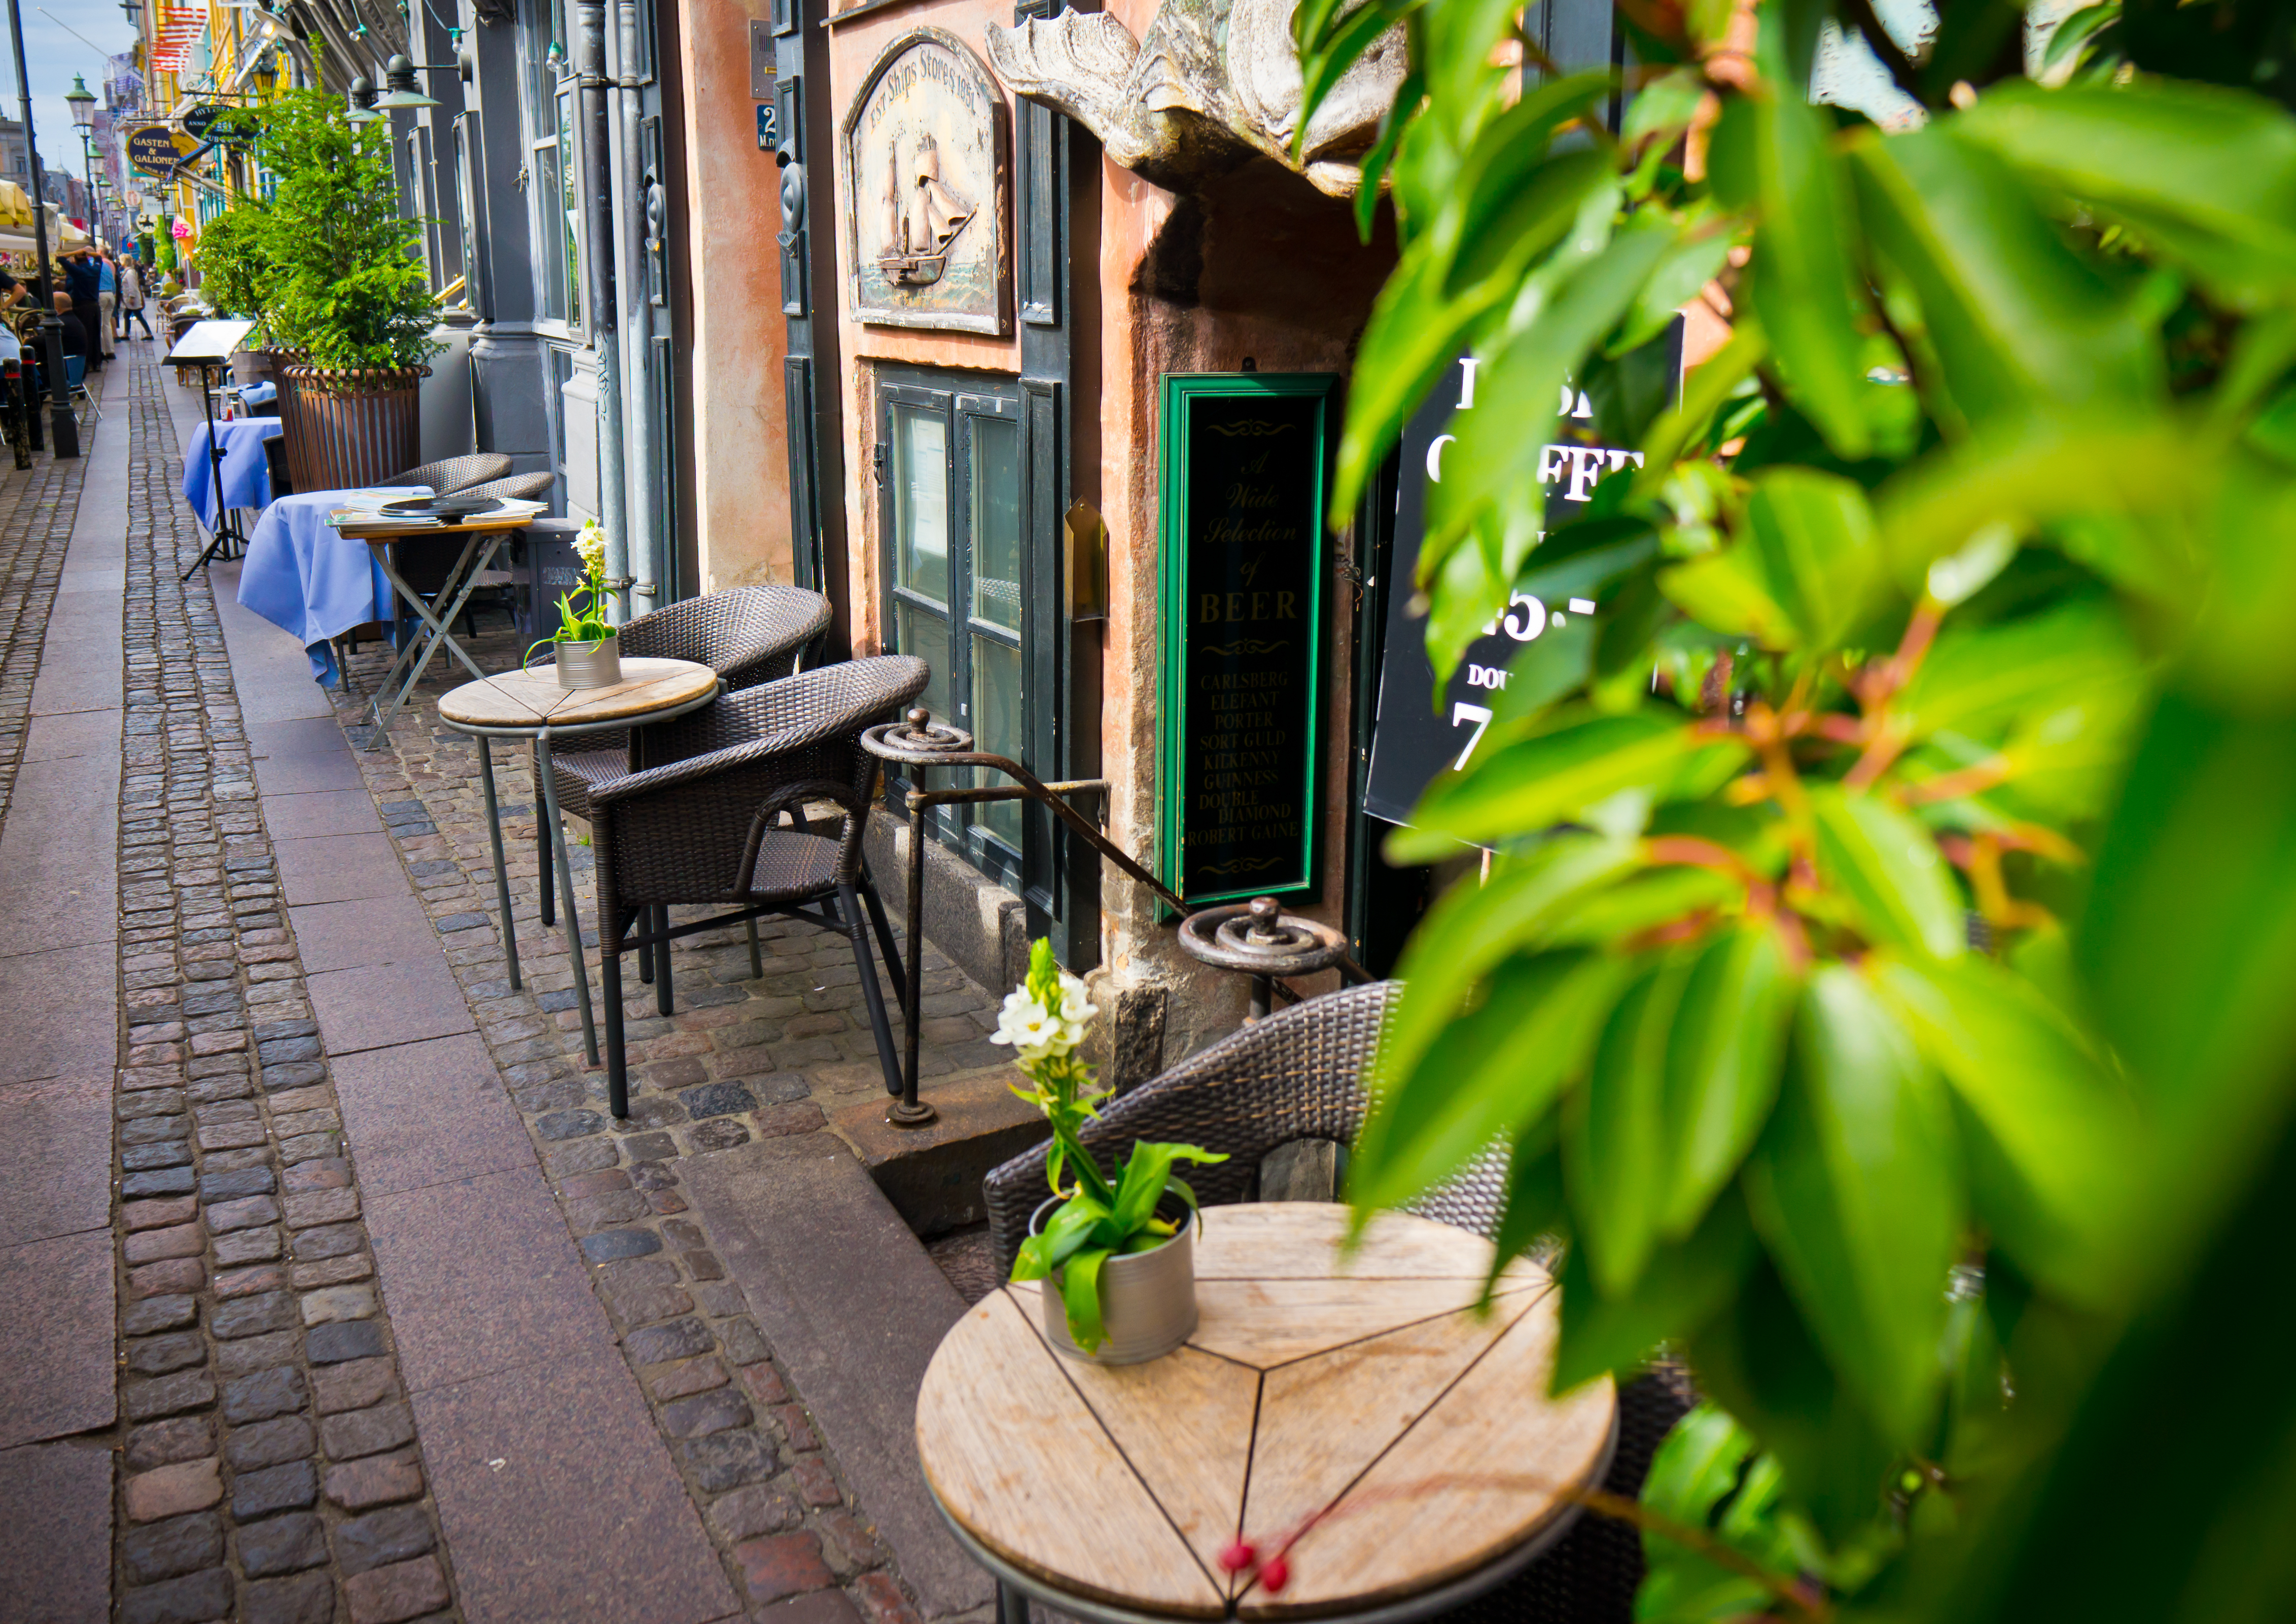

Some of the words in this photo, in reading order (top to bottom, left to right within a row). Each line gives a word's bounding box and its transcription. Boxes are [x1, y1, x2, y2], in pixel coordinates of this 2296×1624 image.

[870, 91, 886, 129] EST
[888, 61, 917, 102] Ships
[920, 49, 956, 90] Stores
[957, 74, 975, 115] 1851
[133, 137, 169, 148] GASTEN
[148, 147, 156, 155] &
[1241, 450, 1271, 475] A
[1225, 483, 1279, 509] Wide
[1204, 517, 1297, 543] Selection
[1240, 551, 1266, 586] of
[1199, 591, 1298, 623] BEER
[1200, 672, 1288, 690] CARLSBERG
[1211, 691, 1280, 711] ELEFANT
[1215, 712, 1274, 730] PORTER
[1200, 733, 1239, 751] SORT
[1244, 730, 1286, 747] GULD
[1204, 750, 1281, 770] KILKENNY
[1204, 769, 1279, 790] GUINNESS
[1199, 790, 1259, 810] DOUBLE
[1218, 803, 1291, 824] DIAMOND
[1188, 826, 1246, 846] ROBERT
[1251, 822, 1298, 840] GAINE
